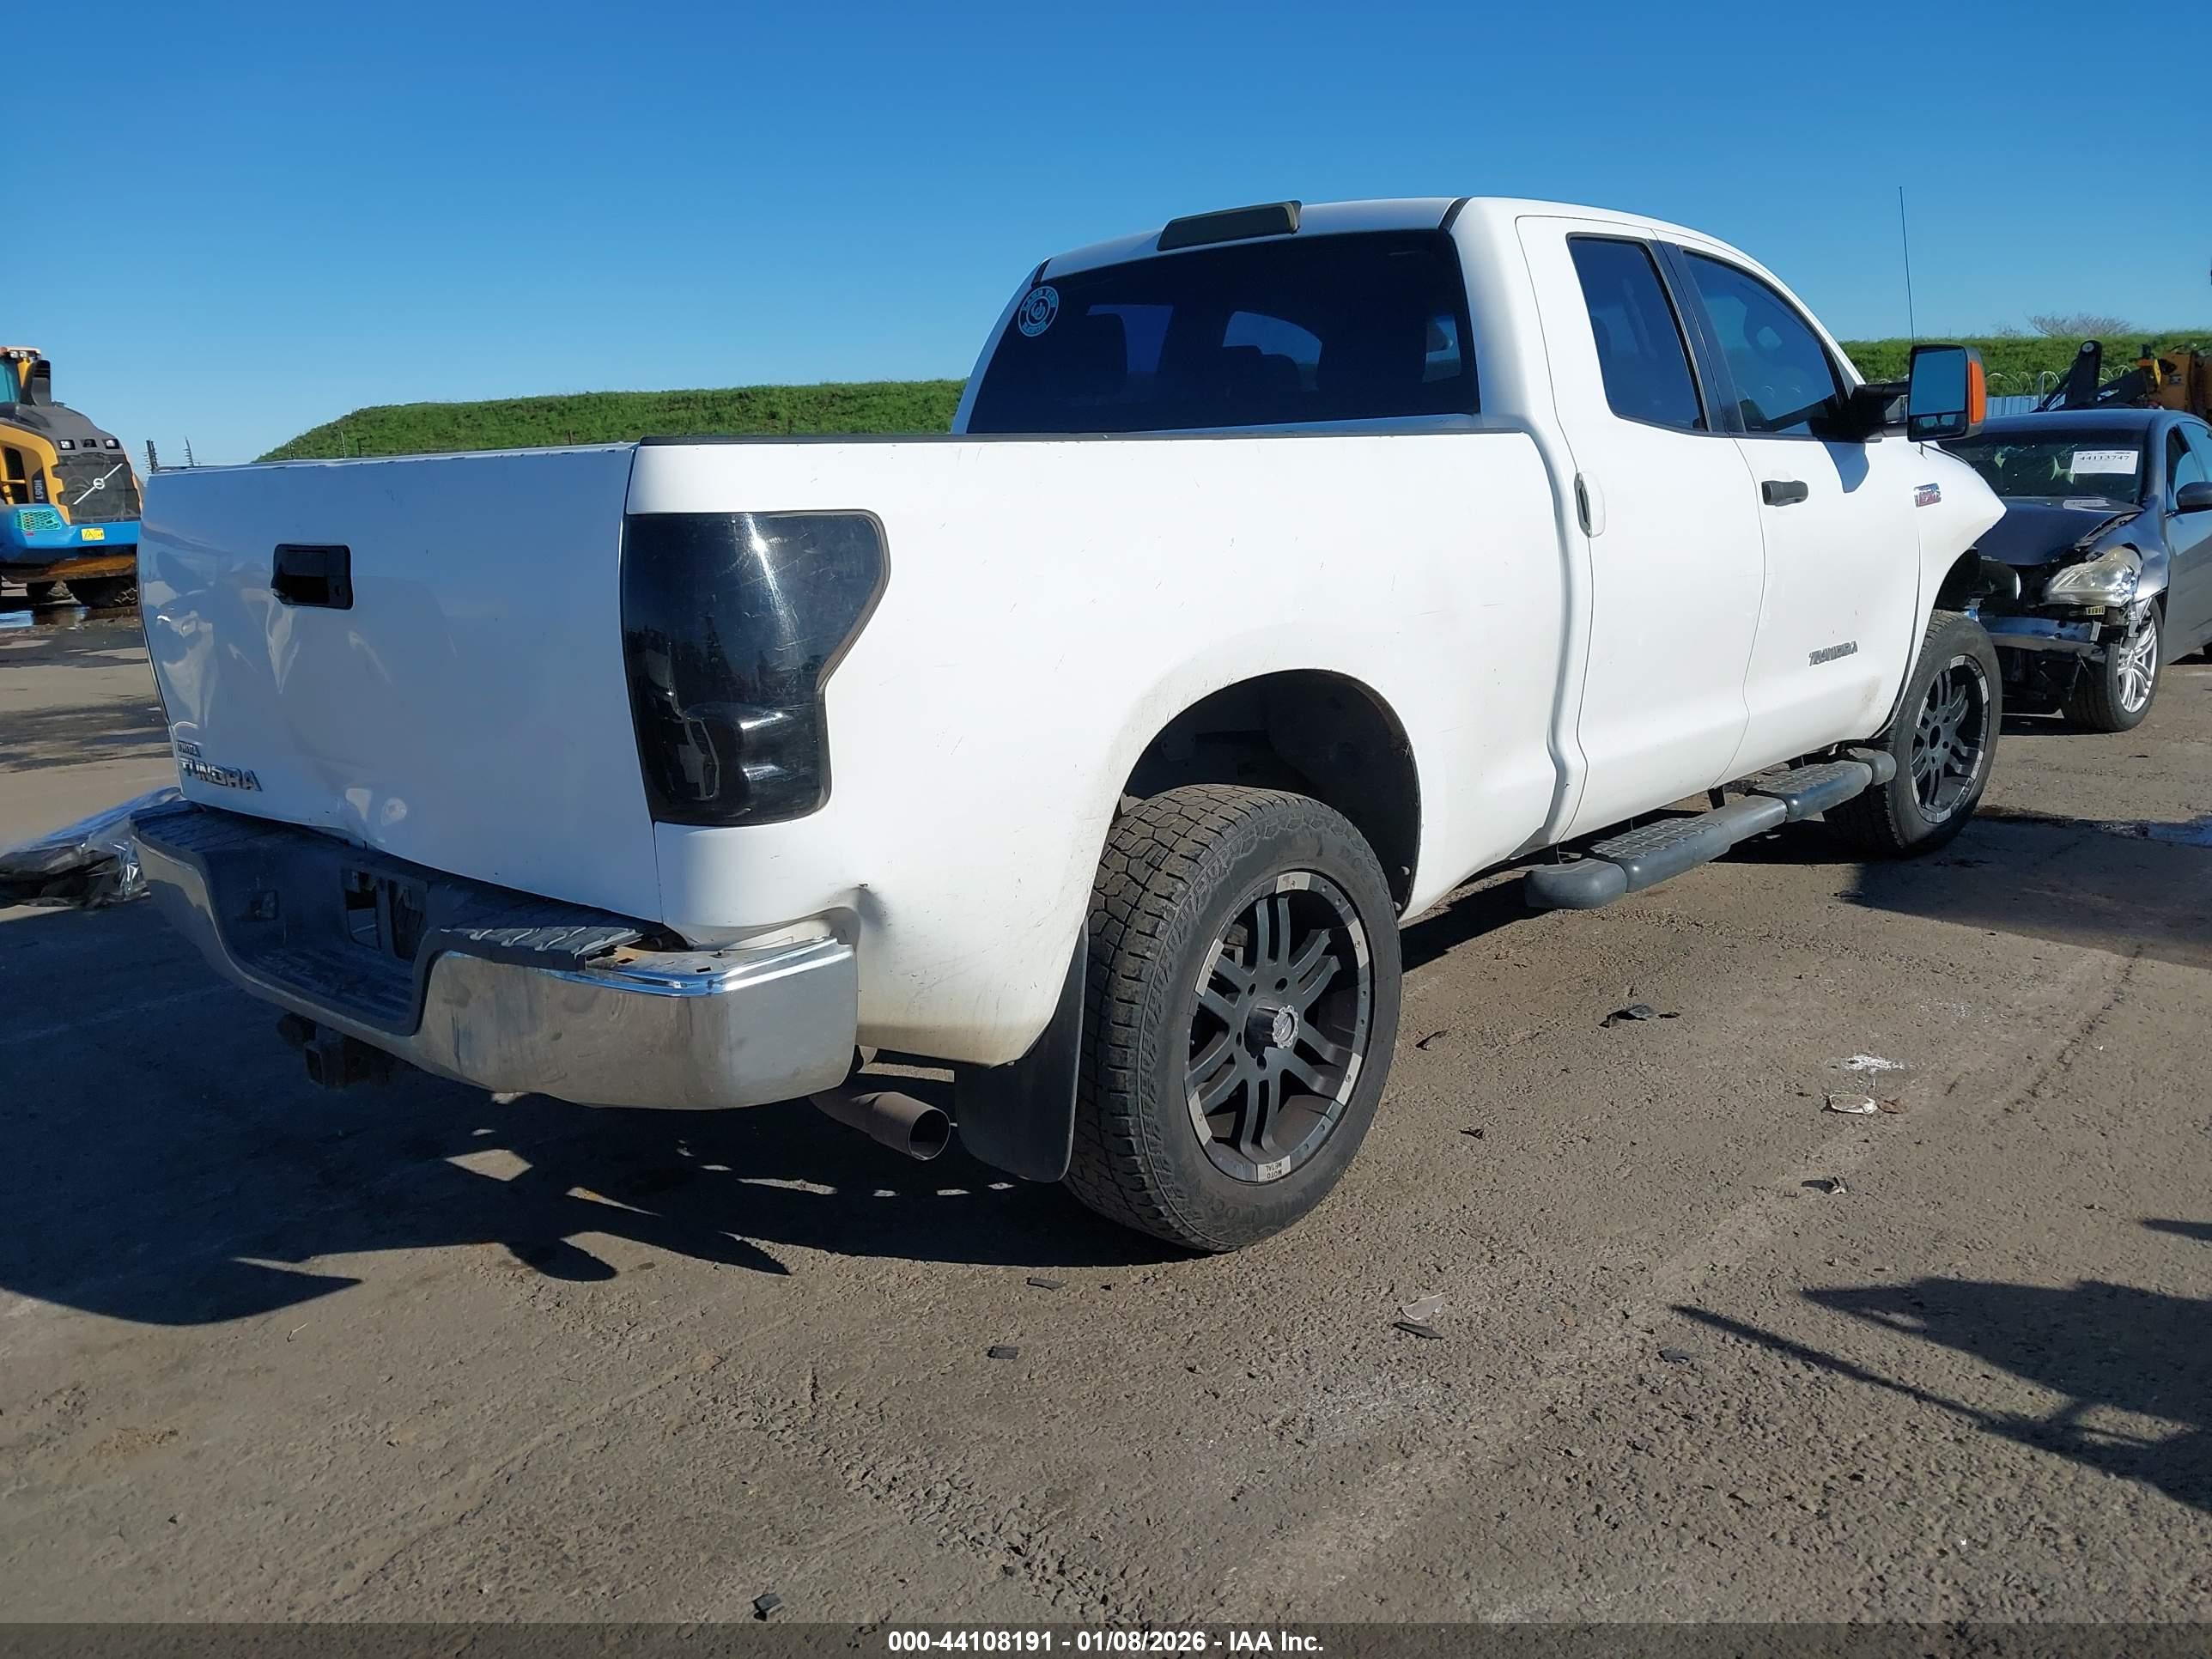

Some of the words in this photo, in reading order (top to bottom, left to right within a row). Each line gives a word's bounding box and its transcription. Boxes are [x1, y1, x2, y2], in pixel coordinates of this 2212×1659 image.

[178, 757, 263, 792] TUNDRA
[1266, 1161, 1283, 1172] METAL
[1267, 1170, 1283, 1179] MOTO
